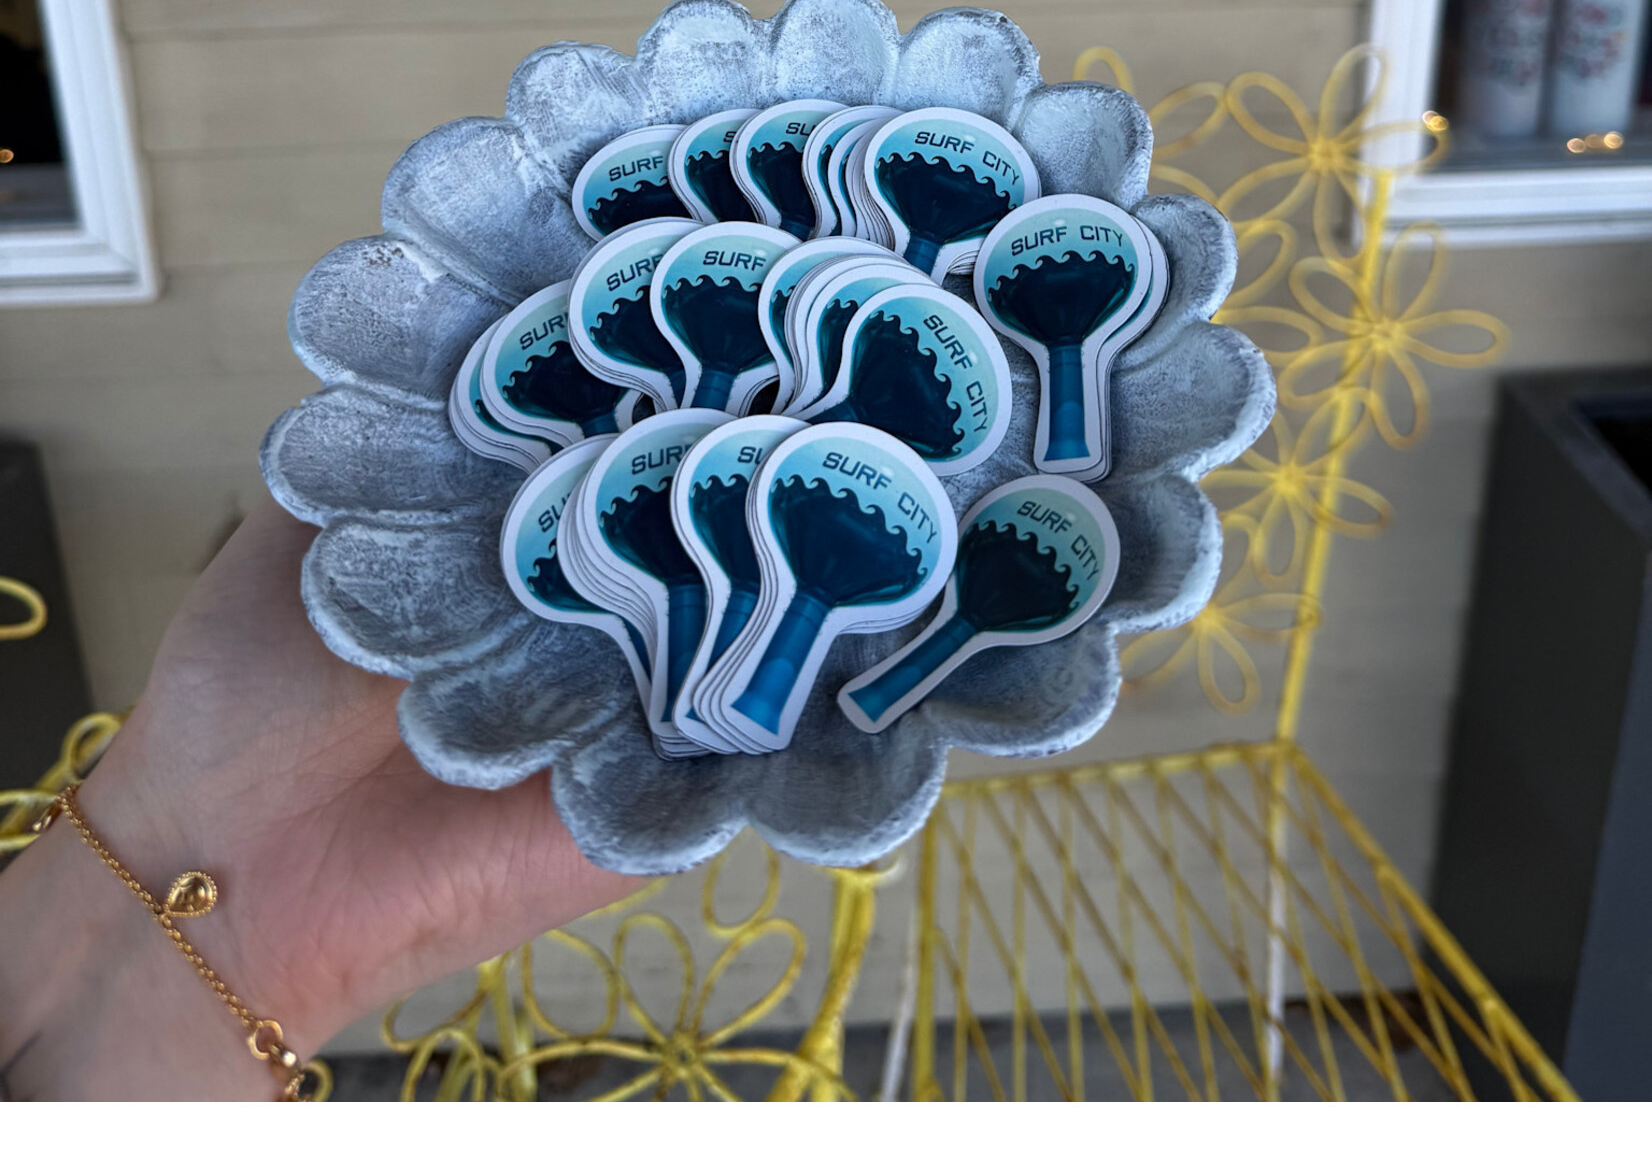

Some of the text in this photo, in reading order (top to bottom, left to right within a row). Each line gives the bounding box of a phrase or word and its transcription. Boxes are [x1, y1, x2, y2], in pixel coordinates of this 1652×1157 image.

[785, 122, 816, 136] SU
[608, 155, 664, 183] SURF
[914, 131, 1020, 186] SURF CITY
[1011, 225, 1123, 257] SURF CITY
[703, 250, 767, 272] SURF
[519, 311, 569, 350] SUR
[923, 314, 988, 433] SURF CITY
[822, 451, 938, 544] SURF CITY
[1016, 500, 1100, 580] SURF CITY
